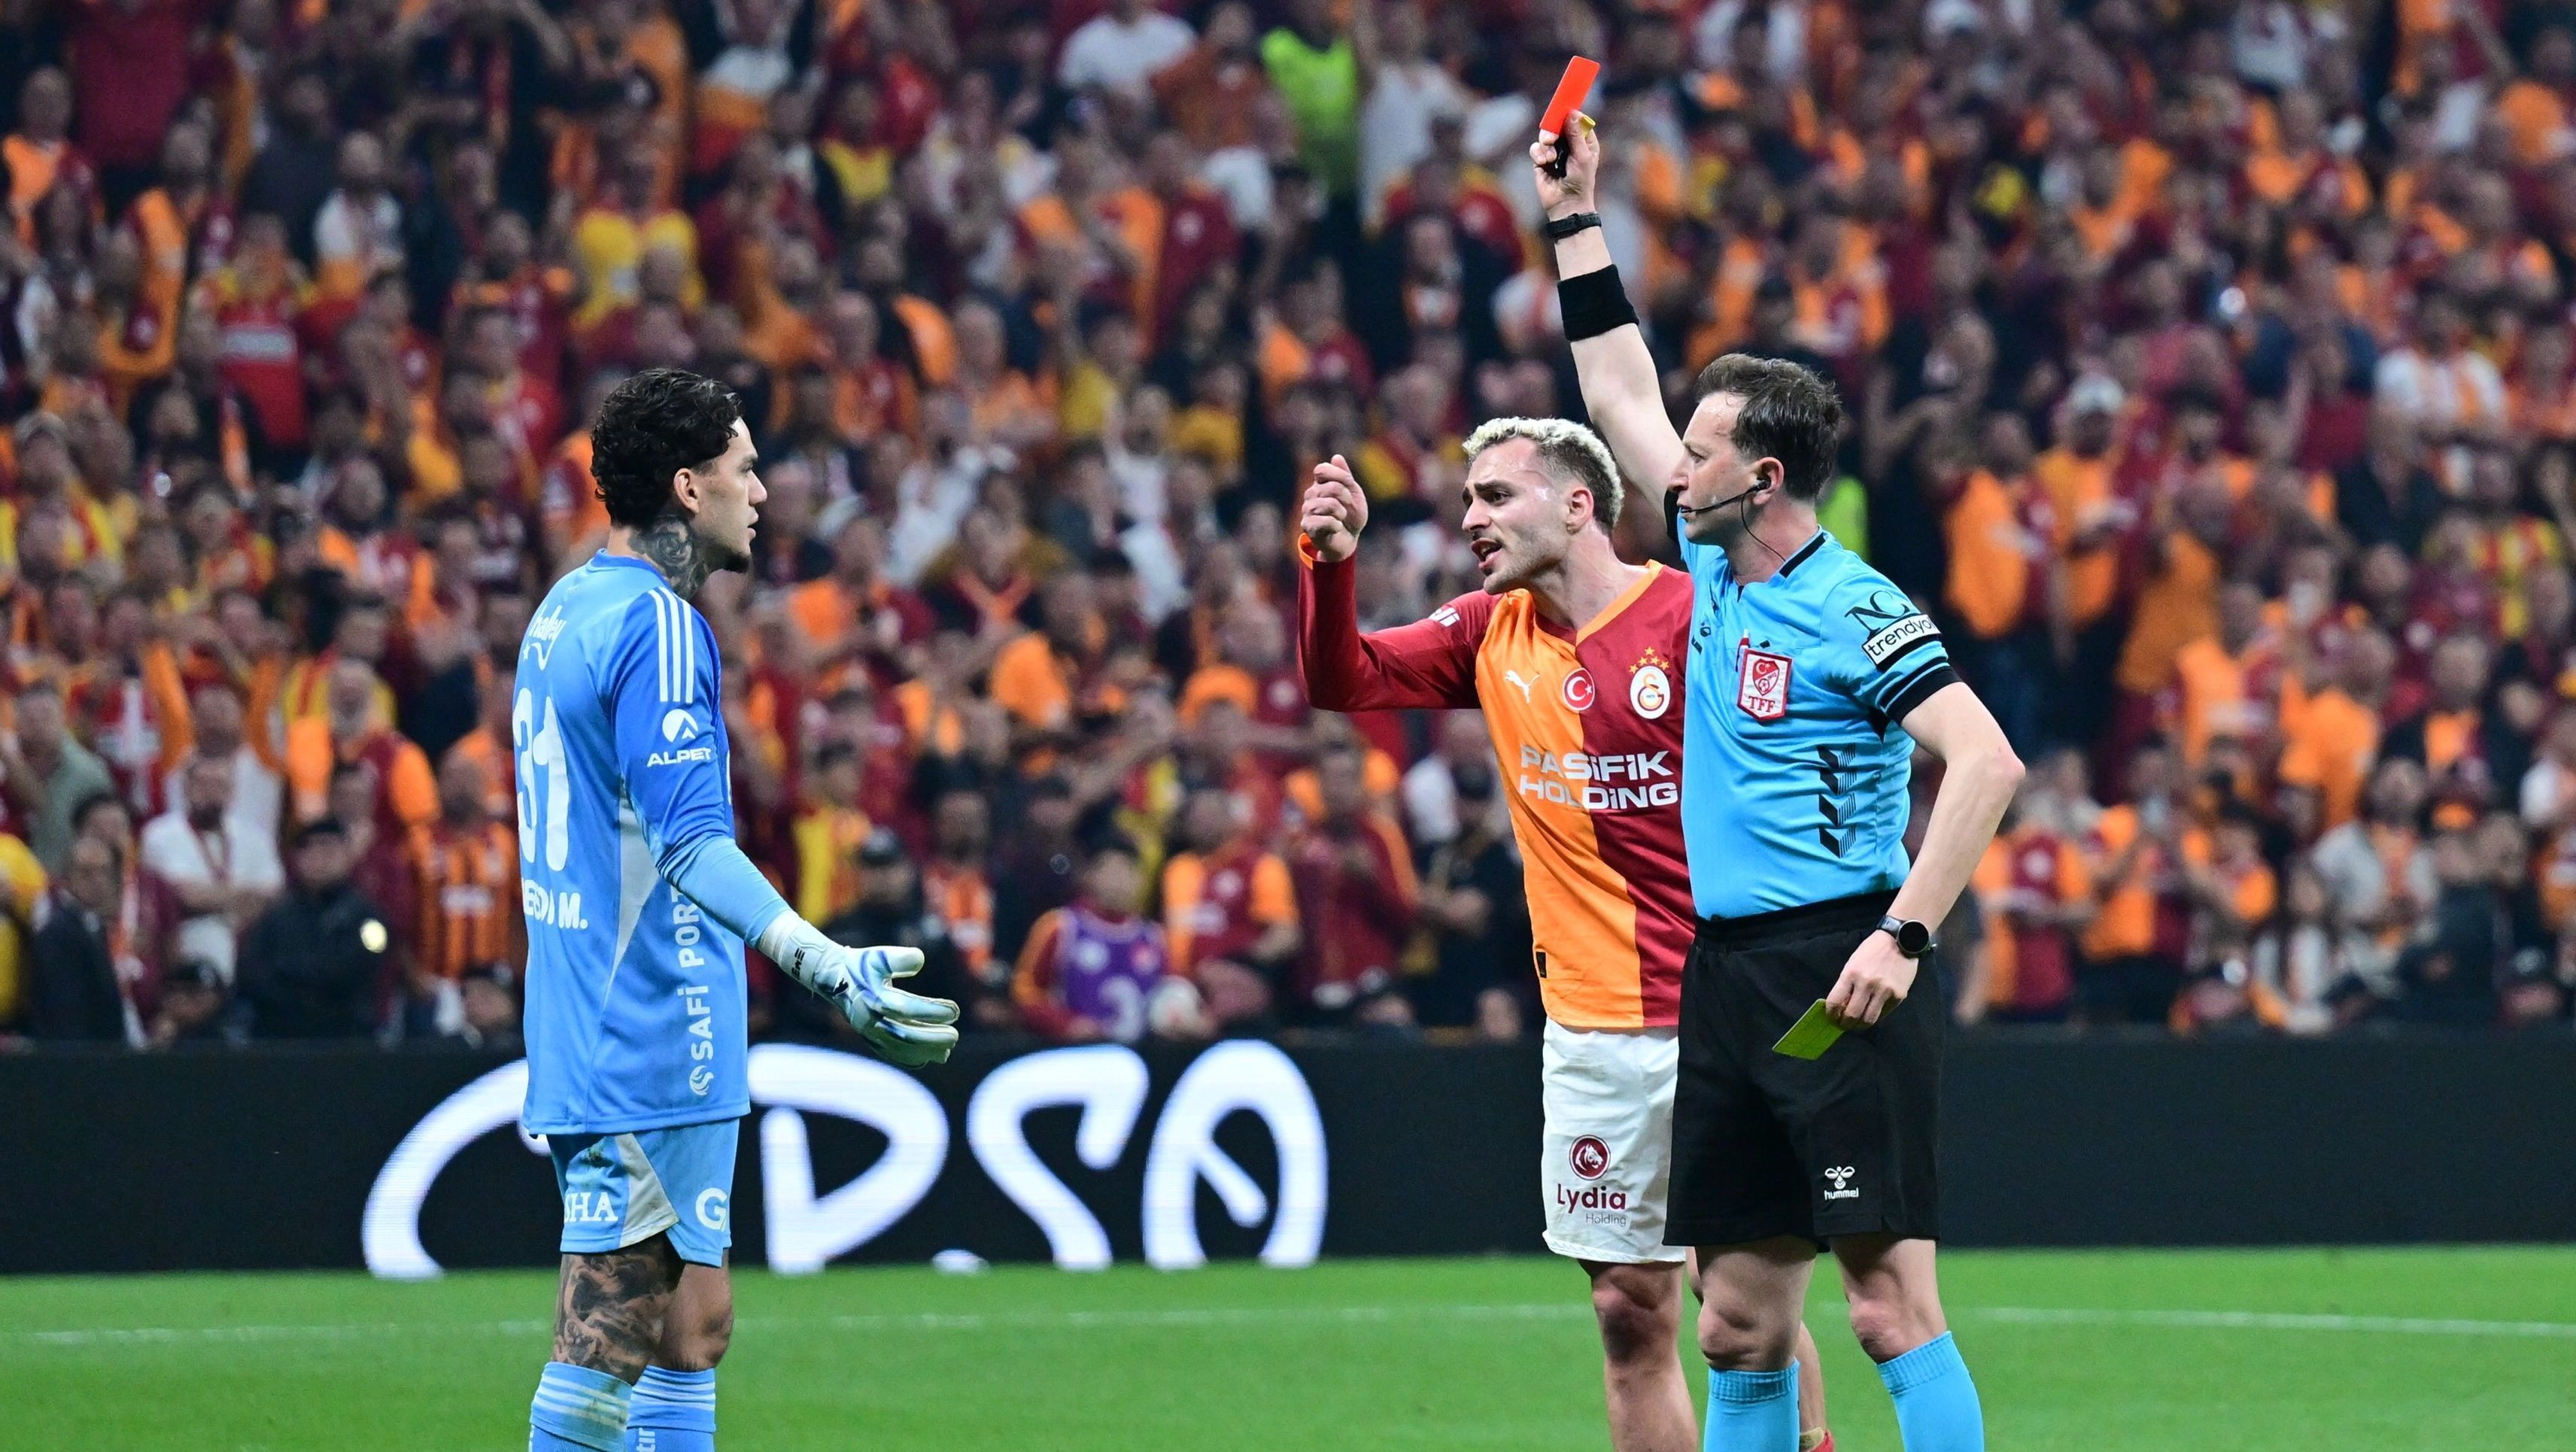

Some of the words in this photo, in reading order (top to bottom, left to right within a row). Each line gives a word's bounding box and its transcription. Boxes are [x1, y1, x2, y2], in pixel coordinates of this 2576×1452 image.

[1748, 695, 1776, 713] TFF
[647, 747, 711, 767] ALPET
[512, 688, 570, 872] 31
[558, 892, 588, 929] M.
[1557, 1183, 1627, 1214] Lydia
[1824, 1187, 1859, 1201] hummel
[696, 1187, 728, 1232] G
[1586, 1213, 1627, 1227] Holding
